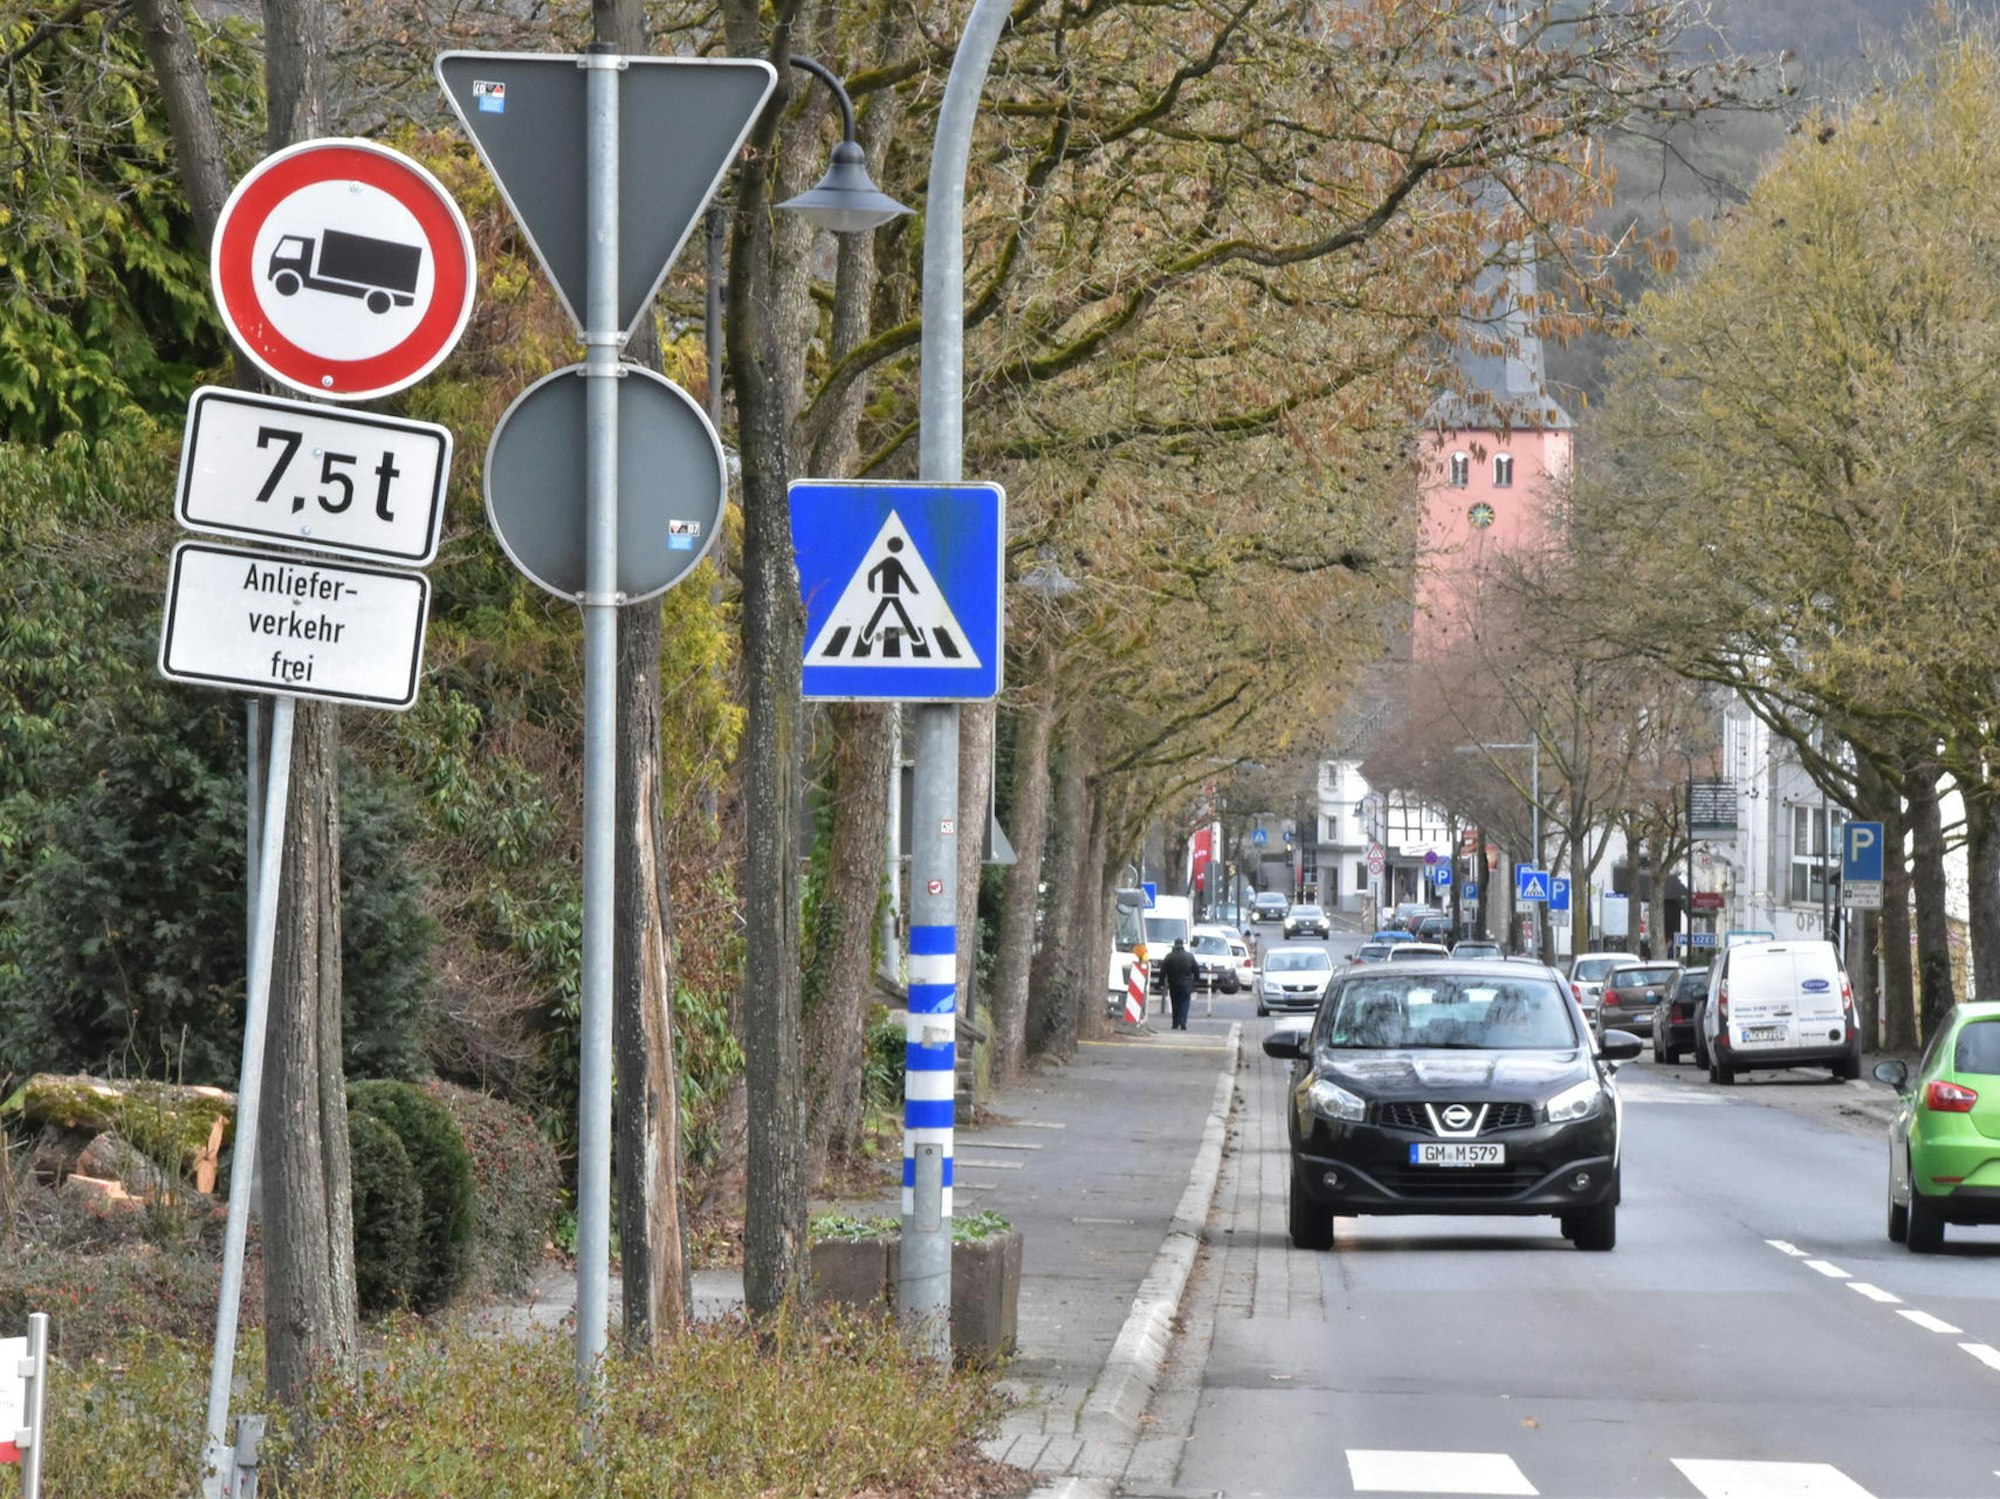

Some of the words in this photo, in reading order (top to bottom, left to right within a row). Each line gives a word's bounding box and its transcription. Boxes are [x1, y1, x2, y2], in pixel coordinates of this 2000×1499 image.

[255, 426, 357, 515] 7,5
[375, 450, 400, 522] t
[243, 562, 358, 601] Anliefer-
[249, 610, 345, 643] verkehr
[271, 651, 314, 681] frei
[1851, 828, 1875, 862] P
[1553, 881, 1565, 900] P
[1679, 935, 1714, 944] PLIZEI
